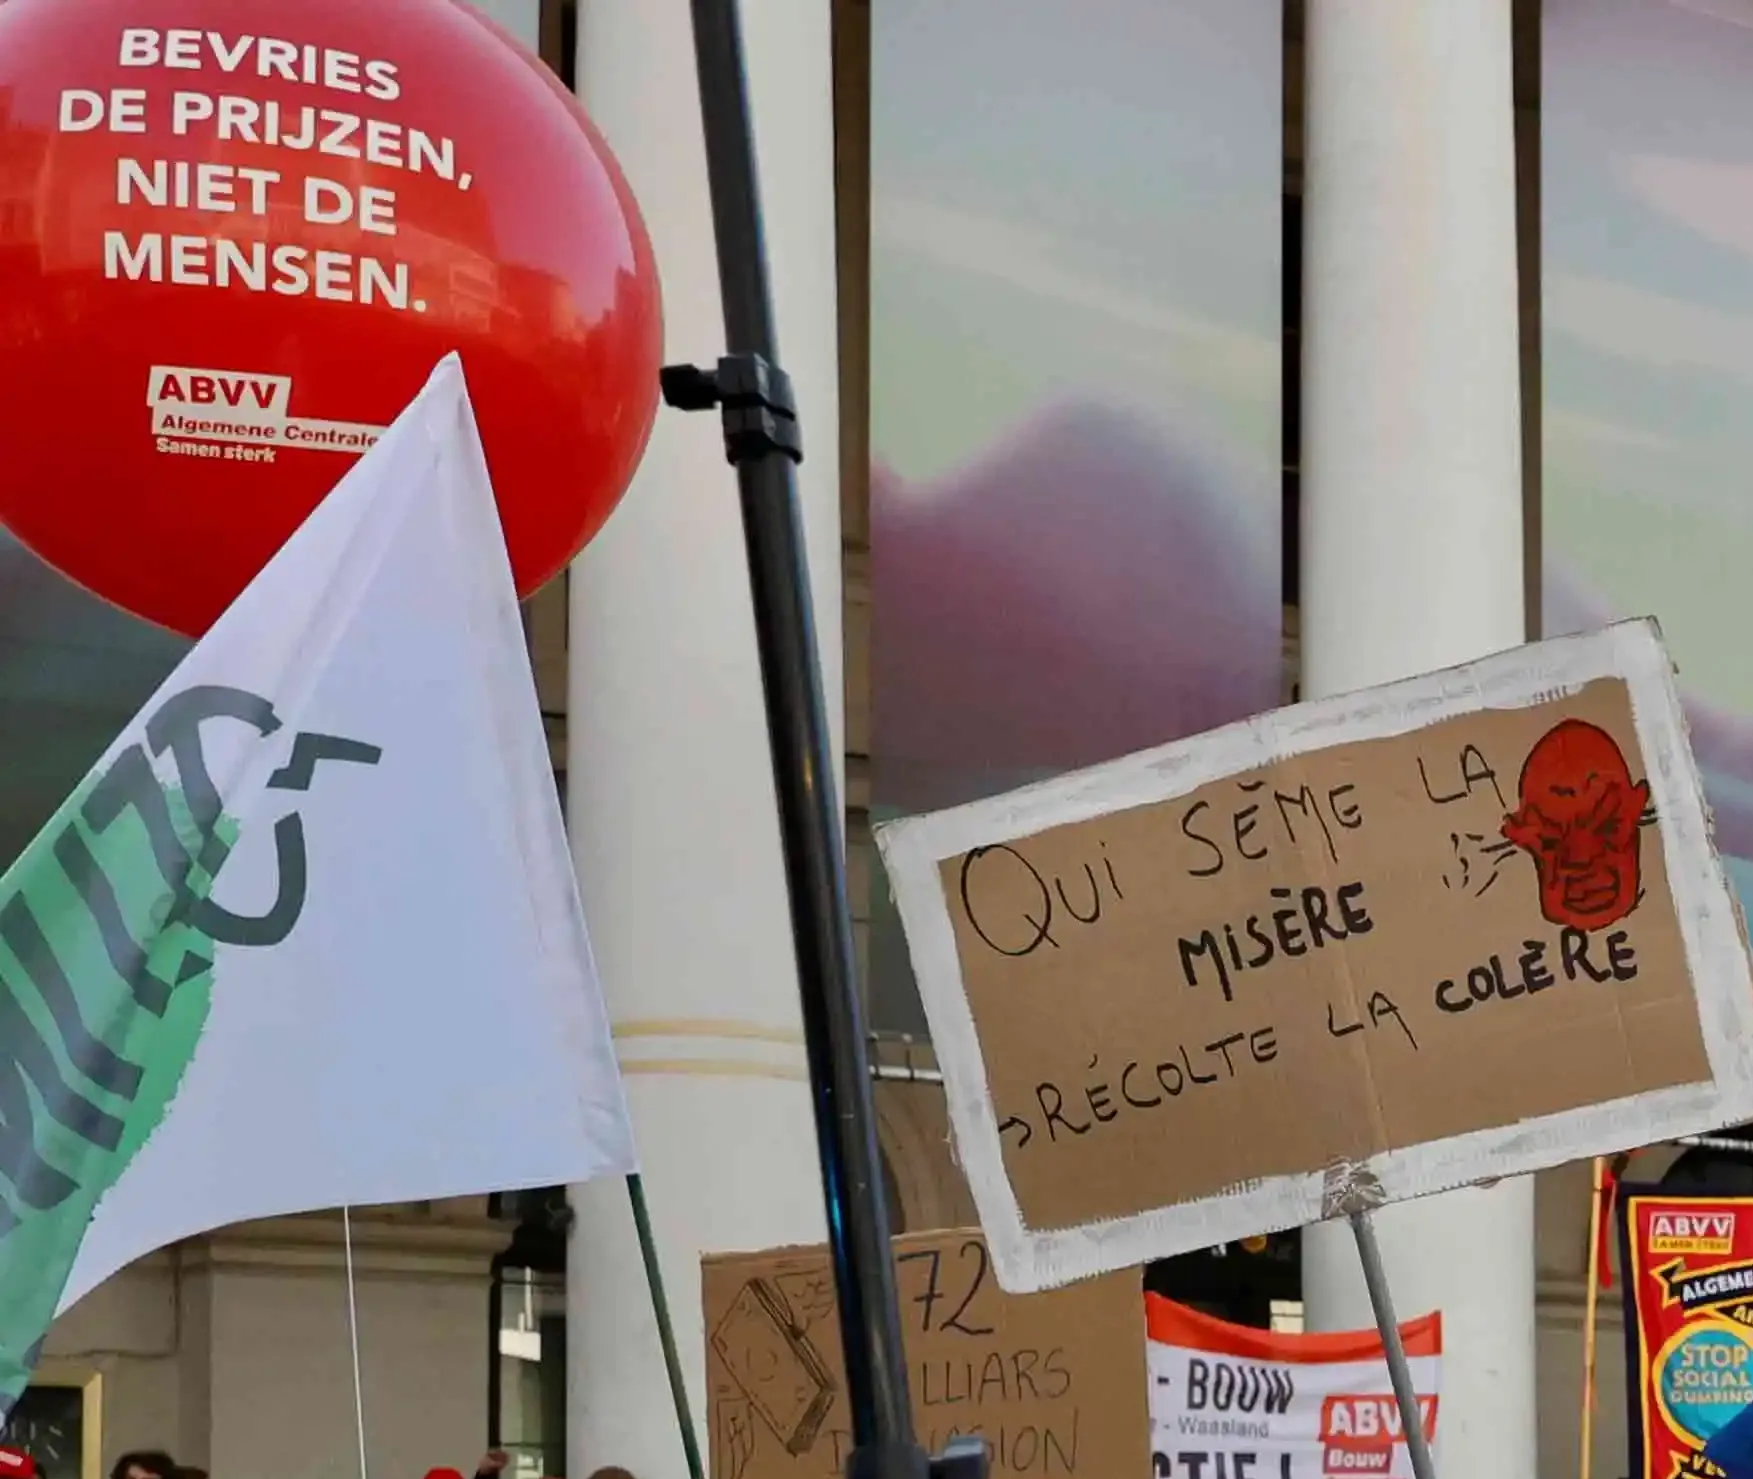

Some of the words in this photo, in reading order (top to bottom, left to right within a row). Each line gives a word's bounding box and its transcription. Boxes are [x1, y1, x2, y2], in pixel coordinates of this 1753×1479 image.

[119, 28, 401, 101] BEVRIES
[58, 89, 147, 134] DE
[172, 93, 474, 191] PRIJZEN,
[116, 159, 280, 215] NIET
[303, 180, 397, 235] DE
[103, 232, 428, 313] MENSEN.
[158, 374, 277, 408] ABVV
[156, 437, 221, 458] Samen
[223, 446, 276, 463] sterk
[161, 414, 276, 438] Algemene
[284, 425, 378, 447] Centrale
[1416, 742, 1510, 811] LA
[1327, 991, 1421, 1052] LA
[1655, 1216, 1730, 1237] ABVV
[897, 1239, 996, 1338] 72
[1672, 1369, 1751, 1388] SOCIAL
[1681, 1342, 1748, 1368] STOP
[1187, 1358, 1295, 1415] BOUW
